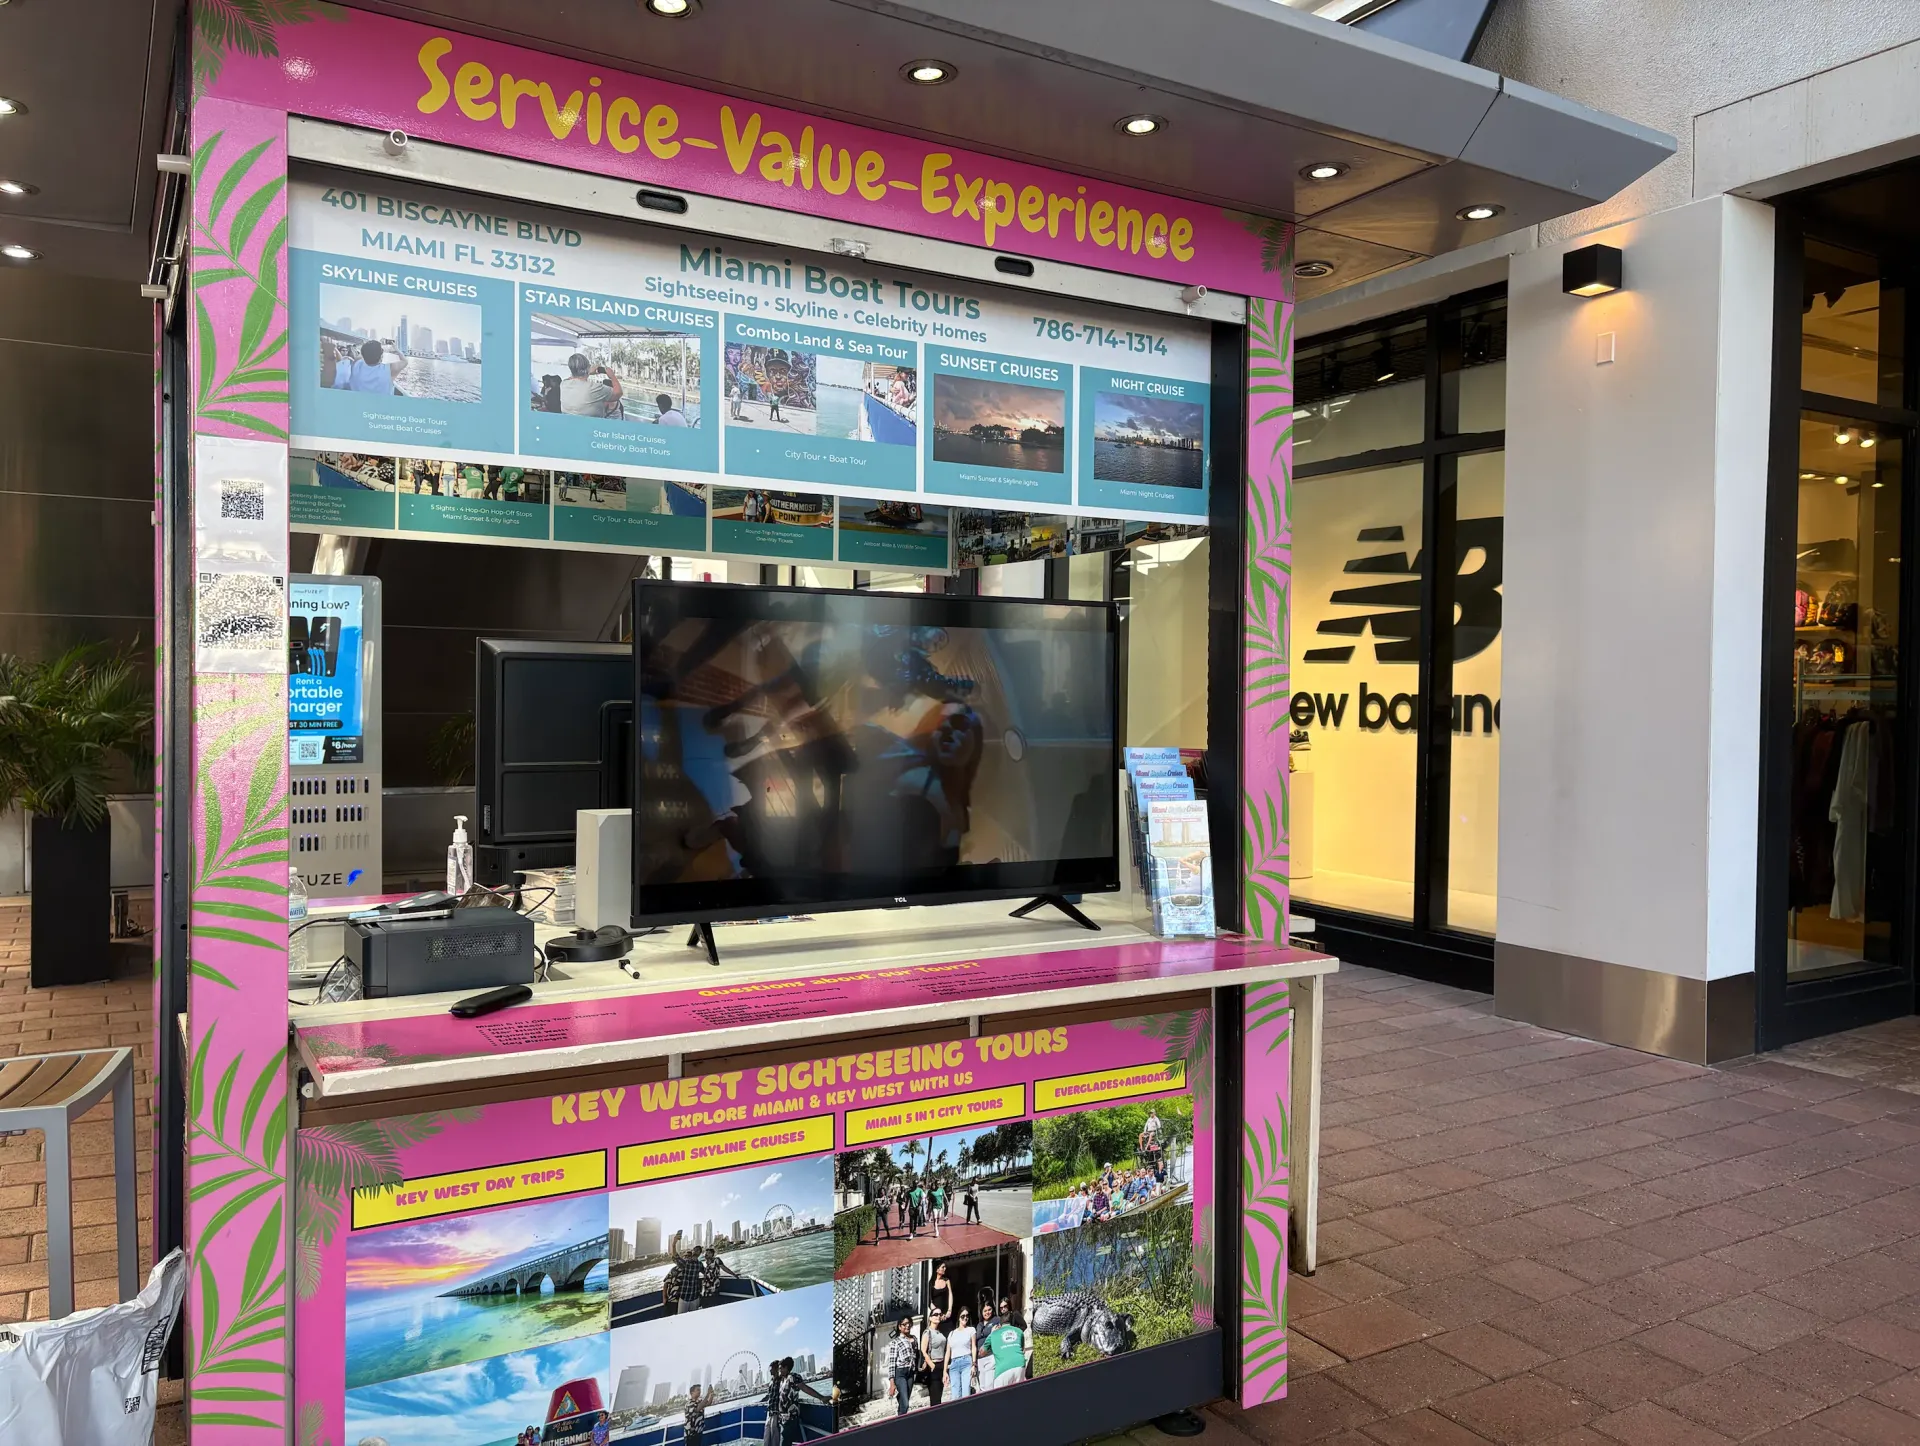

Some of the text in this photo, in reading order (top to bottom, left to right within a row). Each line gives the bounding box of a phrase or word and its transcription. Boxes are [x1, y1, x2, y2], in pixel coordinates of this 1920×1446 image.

[417, 37, 1195, 262] Service-Value-Experience
[321, 187, 582, 247] 401 BISCAYNE BLVD
[361, 228, 556, 276] MIAMI FL 33132
[322, 263, 477, 298] SKYLINE CRUISES
[680, 243, 981, 320] Miami Boat Tours
[525, 289, 715, 329] STAR ISLAND CRUISES
[645, 276, 988, 344] Sightseeing Skyline Celebrity Homes
[736, 323, 908, 361] Combo Land & Sea Tour
[1032, 316, 1168, 356] 786-714-1314
[939, 352, 1059, 382] SUNSET CRUISES
[1111, 377, 1185, 397] NIGHT CRUISE
[362, 411, 447, 427] Sightseeing Boat Tours
[368, 421, 442, 435] Sunset Boat Cruises
[590, 440, 671, 457] Celebrity Boat Tours
[593, 429, 667, 445] Star Island Cruises
[785, 449, 801, 461] City
[802, 451, 820, 462] Tour
[829, 454, 848, 465] Boat
[849, 456, 867, 466] Tour
[959, 473, 977, 482] Miami
[977, 475, 997, 483] Sunset
[1002, 478, 1022, 487] Skyline
[1023, 478, 1039, 488] lights
[769, 498, 817, 513] OUTHERNMOST
[1120, 488, 1175, 500] Miami Night Cruises
[436, 504, 456, 512] Sights
[516, 510, 533, 518] Stops
[463, 514, 484, 522] Sunset
[592, 514, 606, 523] City
[778, 511, 801, 523] POINT
[321, 600, 350, 610] Low?
[289, 685, 343, 699] ortable
[295, 677, 315, 685] Rent
[289, 699, 343, 717] harger
[1289, 691, 1349, 730] ew
[698, 980, 806, 997] Questions
[809, 972, 872, 986] about
[877, 968, 912, 978] our
[914, 961, 981, 974] Tours?
[551, 1026, 1069, 1126] KEY WEST SIGHTSEEING TOURS
[670, 1071, 974, 1131] EXPLORE MIAMI & KEY WEST WITH US
[865, 1114, 902, 1131] MIAMI
[905, 1113, 913, 1124] 5
[915, 1111, 928, 1122] IN
[937, 1104, 964, 1119] CITY
[966, 1097, 1004, 1114] TOURS
[642, 1130, 806, 1168] MIAMI SKYLINE CRUISES
[395, 1168, 566, 1207] KEY WEST DAY TRIPS
